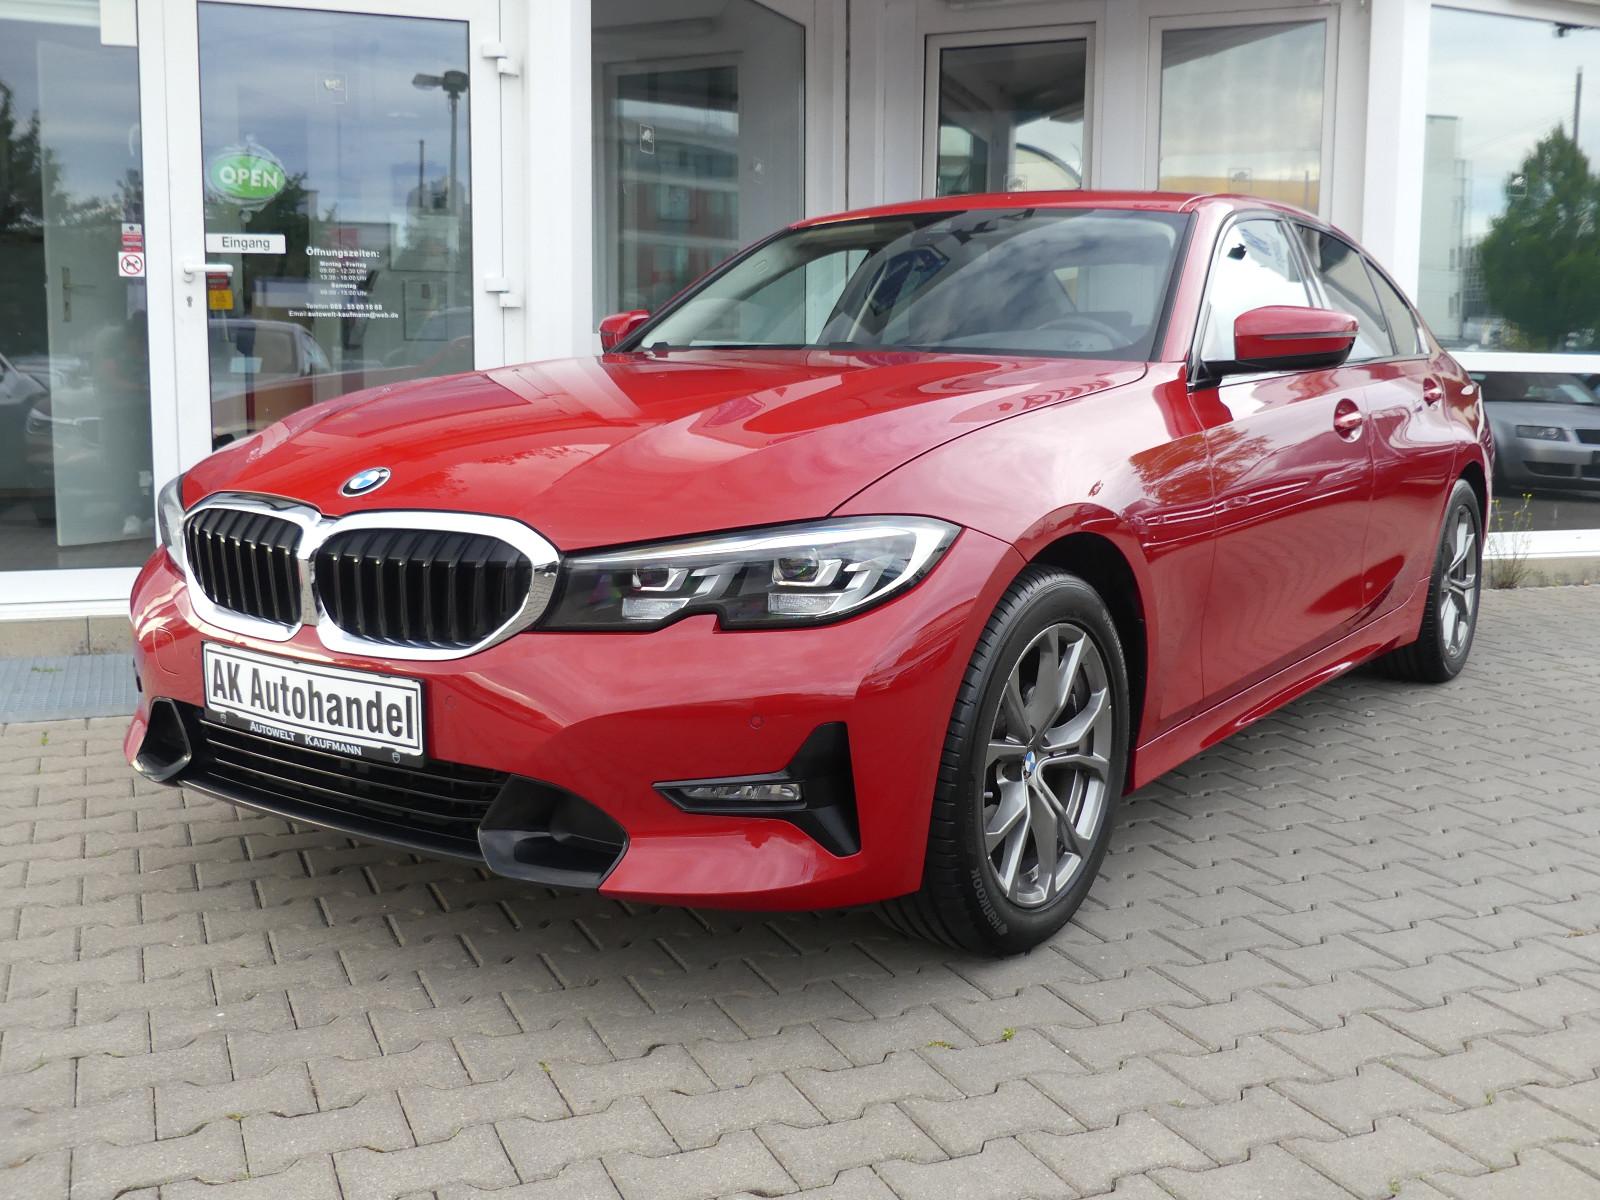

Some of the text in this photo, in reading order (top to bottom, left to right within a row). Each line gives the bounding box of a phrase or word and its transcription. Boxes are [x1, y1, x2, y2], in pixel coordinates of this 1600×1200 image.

[219, 166, 278, 190] OPEN
[221, 236, 270, 251] Eingang
[305, 246, 380, 258] Öffnungszeiten:
[346, 261, 367, 269] Freitag
[331, 282, 357, 290] Samstag
[212, 658, 415, 740] AK Autohandel
[250, 721, 362, 756] AUTOWELT KAUFMANN
